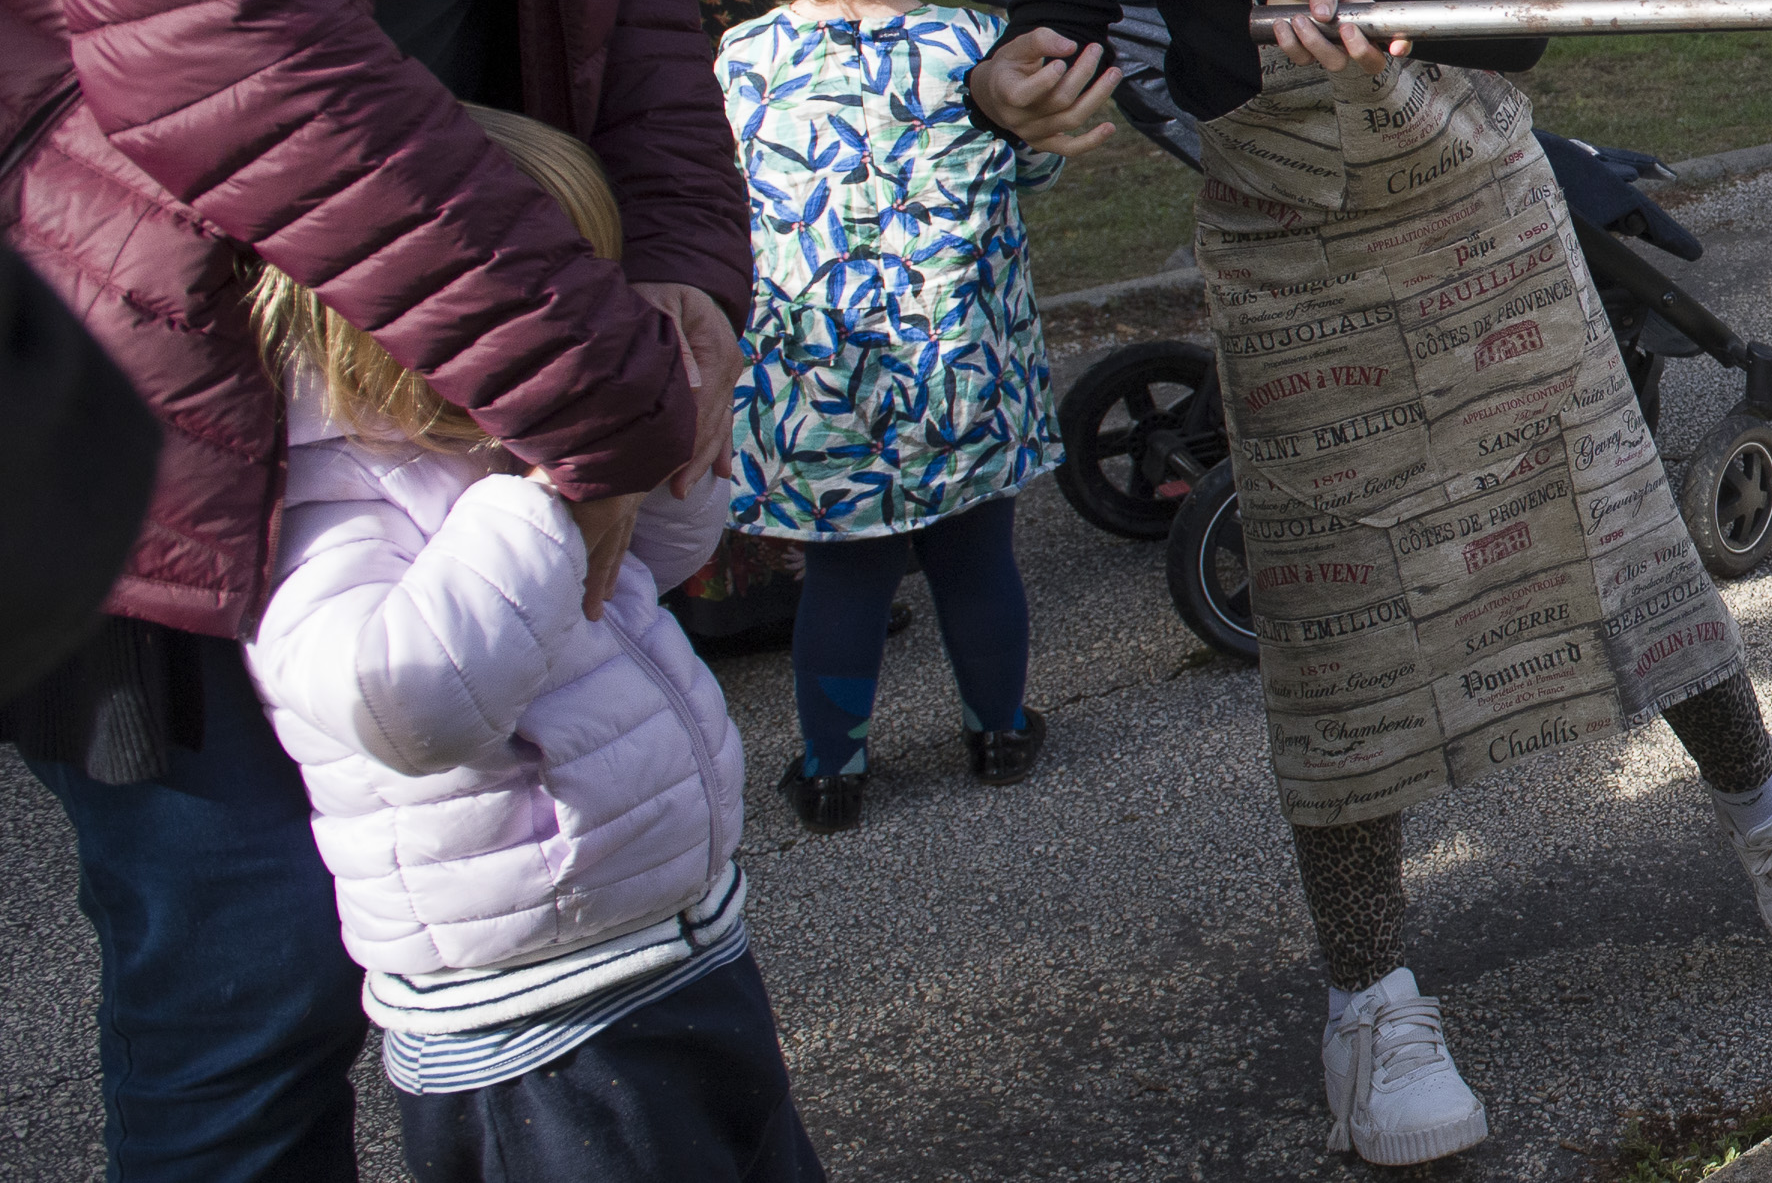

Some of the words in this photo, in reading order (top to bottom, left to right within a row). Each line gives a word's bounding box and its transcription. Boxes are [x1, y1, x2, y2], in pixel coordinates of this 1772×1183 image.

[1387, 137, 1474, 195] Chablis
[1503, 149, 1525, 167] 1996
[1517, 222, 1549, 243] 1950
[1454, 236, 1497, 267] Pape
[1216, 267, 1252, 280] 1870
[1418, 244, 1554, 318] PAUILLAC
[1238, 308, 1284, 326] Produce
[1300, 297, 1346, 314] France
[1415, 324, 1471, 360] CÔTES
[1473, 314, 1493, 338] DE
[1497, 278, 1573, 324] PROVENCE
[1244, 371, 1311, 416] MOULIN
[1316, 370, 1327, 389] à
[1330, 366, 1389, 388] VENT
[1562, 388, 1606, 414] Nuits
[1462, 397, 1526, 427] APPELLATION
[1242, 434, 1302, 463] SAINT
[1311, 401, 1426, 452] EMILION
[1311, 468, 1358, 489] 1870
[1398, 525, 1456, 556] CÔTES
[1458, 513, 1483, 539] DE
[1488, 479, 1568, 527] PROVENCE
[1599, 528, 1625, 547] 1996
[1305, 563, 1315, 583] à
[1318, 563, 1375, 585] VENT
[1614, 559, 1648, 588] Clos
[1255, 618, 1292, 643] SAINT
[1301, 596, 1411, 642] EMILION
[1453, 593, 1512, 629] APPELLATION
[1465, 602, 1571, 657] SANCERRE
[1633, 630, 1684, 681] MOULIN
[1686, 628, 1695, 646] à
[1694, 620, 1726, 643] VENT
[1294, 662, 1416, 700] Saint-Georges
[1300, 661, 1341, 677] 1870
[1458, 641, 1583, 699] Pommard
[1535, 667, 1576, 687] Pommard
[1492, 697, 1514, 713] Côte
[1537, 683, 1566, 698] France
[1314, 715, 1427, 743] Chambertin
[1488, 715, 1580, 765] Chablis
[1585, 718, 1612, 734] 1992
[1349, 749, 1384, 763] France
[1285, 768, 1439, 824] Gewurztraminer
